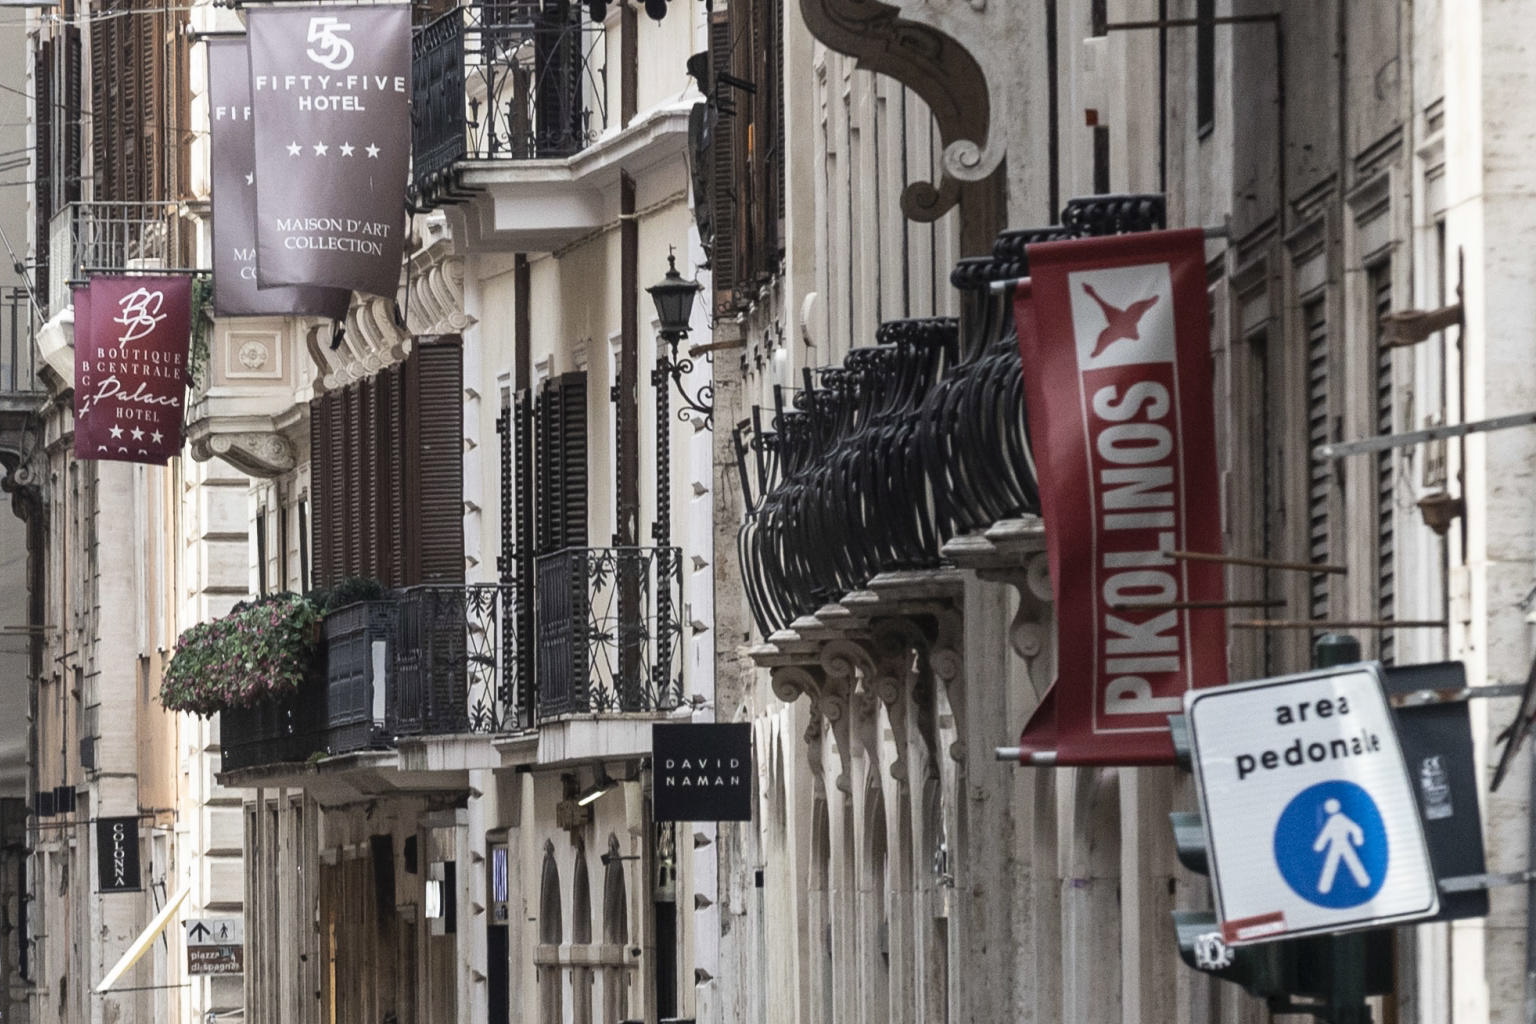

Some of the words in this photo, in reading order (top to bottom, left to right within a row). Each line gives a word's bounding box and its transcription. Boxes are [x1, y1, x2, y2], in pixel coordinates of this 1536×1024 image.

[256, 75, 406, 93] FIFTY-FIVE
[298, 96, 366, 112] HOTEL
[276, 218, 342, 233] MAISON
[347, 222, 390, 237] D'ART
[284, 237, 383, 256] COLLECTION
[97, 348, 181, 365] BOUTIQUE
[97, 362, 181, 379] CENTRALE
[93, 376, 180, 407] Palace
[116, 407, 160, 422] HOTEL
[1092, 380, 1181, 716] PIKOLINOS
[1275, 697, 1350, 725] area
[666, 759, 740, 769] DAVID
[666, 776, 740, 786] NAMAN
[113, 823, 125, 887] COLONNA
